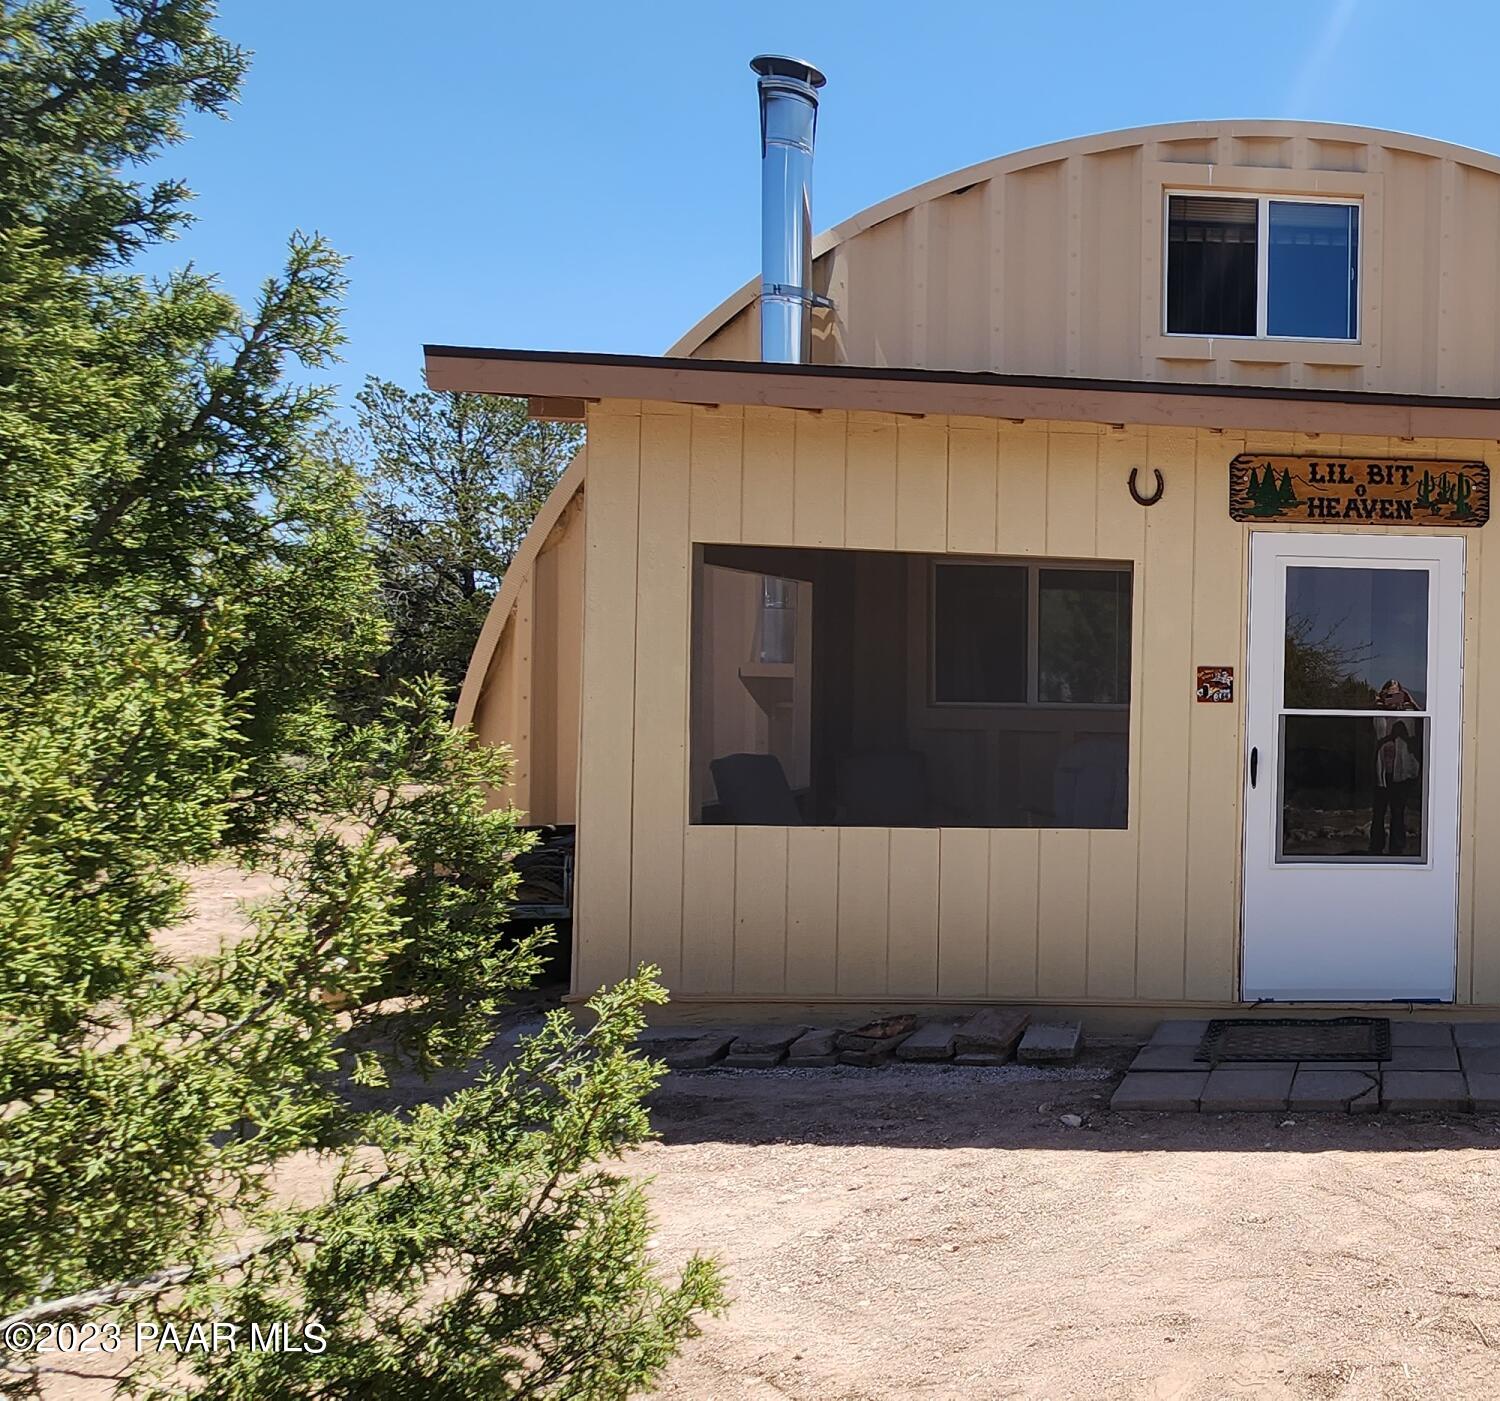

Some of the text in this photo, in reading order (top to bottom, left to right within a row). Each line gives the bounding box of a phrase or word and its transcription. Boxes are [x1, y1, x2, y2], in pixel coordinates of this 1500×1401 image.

[1308, 463, 1414, 486] LIL BIT
[1307, 497, 1413, 520] HEAVEN
